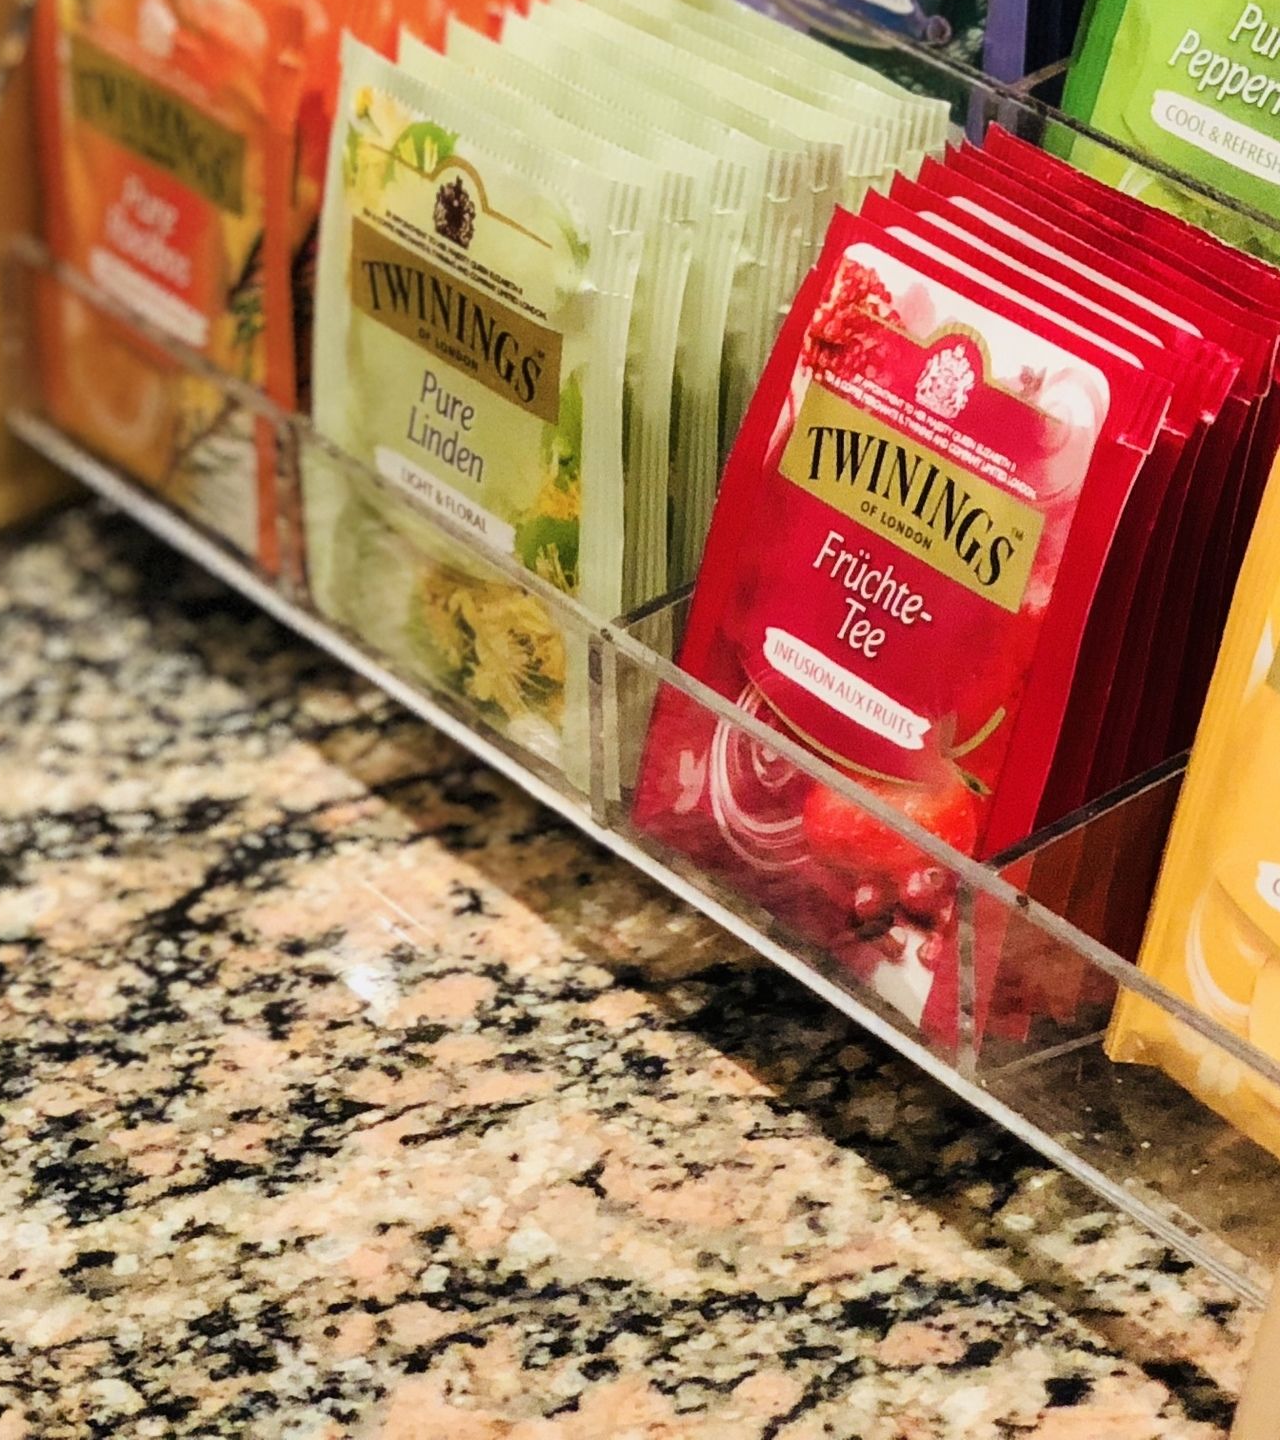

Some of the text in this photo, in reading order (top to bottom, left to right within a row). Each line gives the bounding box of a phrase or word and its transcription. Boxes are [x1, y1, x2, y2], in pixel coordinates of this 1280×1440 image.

[1166, 105, 1206, 137] COOL
[1208, 126, 1218, 143] &
[362, 261, 542, 404] TWININGS
[420, 370, 476, 431] Pure
[406, 409, 485, 484] Linden
[445, 495, 488, 534] FLORAL
[806, 425, 1015, 588] TWININGS
[860, 500, 932, 552] OF LONDON
[812, 530, 933, 626] Früchte-
[836, 597, 886, 659] Tee
[773, 639, 913, 740] INFUSION AUX FRUITS
